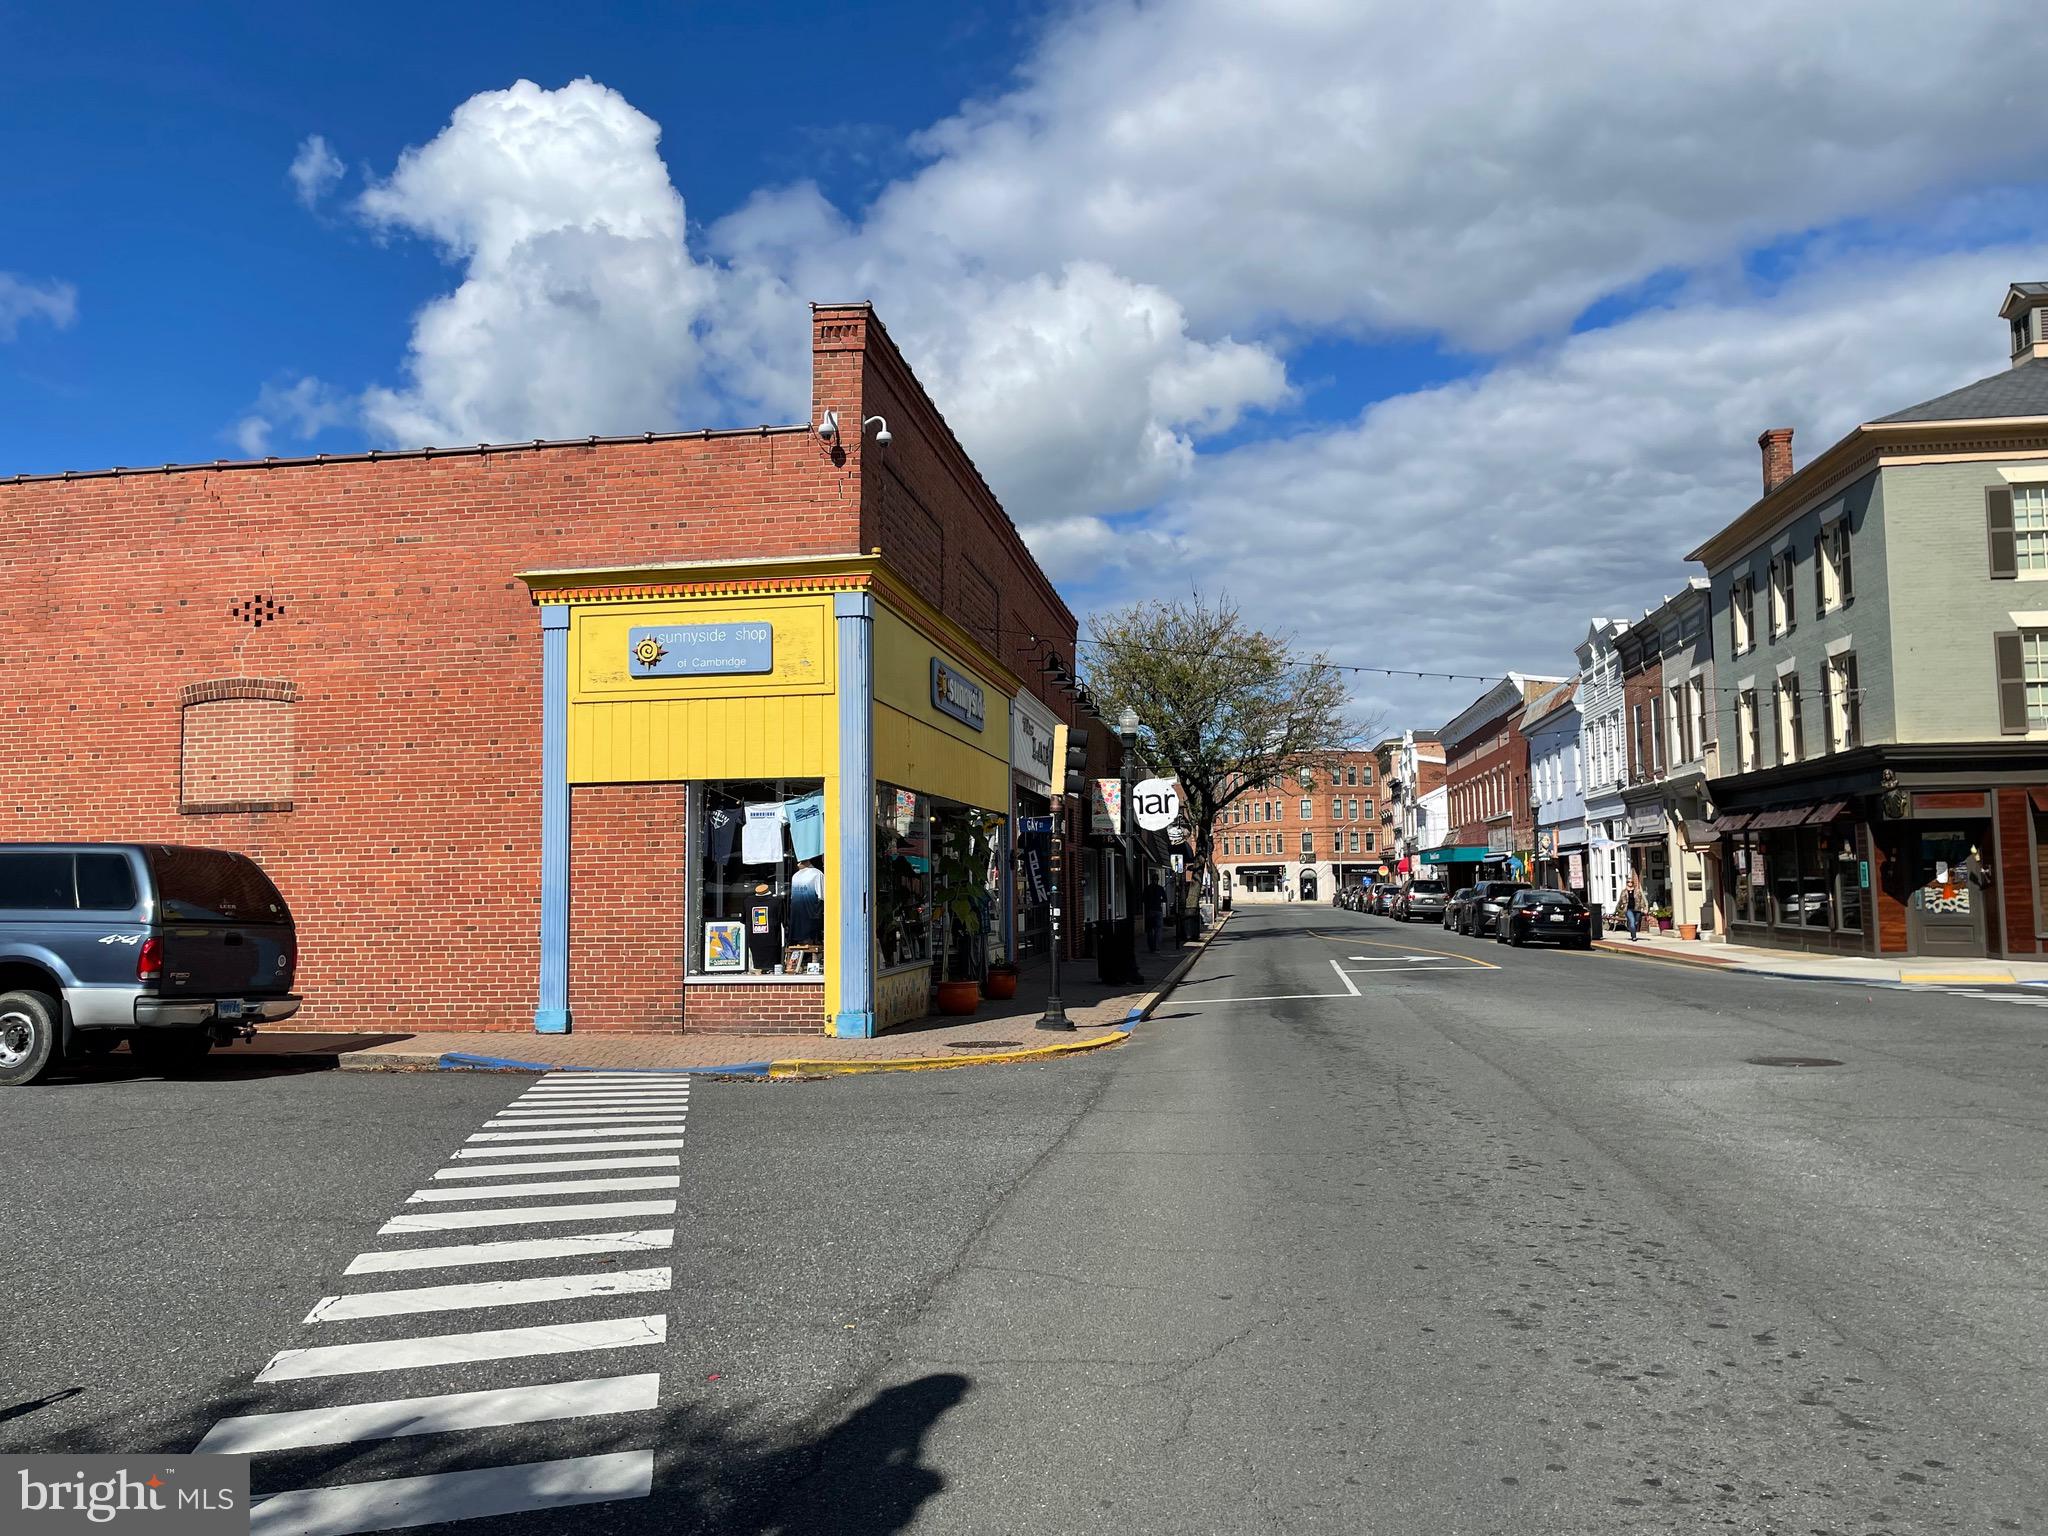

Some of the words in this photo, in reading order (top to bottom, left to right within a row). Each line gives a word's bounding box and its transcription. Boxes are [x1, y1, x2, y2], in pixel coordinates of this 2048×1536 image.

[658, 629, 727, 646] sunnyside
[735, 627, 767, 642] shop
[677, 659, 687, 668] of
[692, 657, 747, 668] Cambridge
[1026, 820, 1039, 831] GAY
[1028, 850, 1048, 902] OPEN
